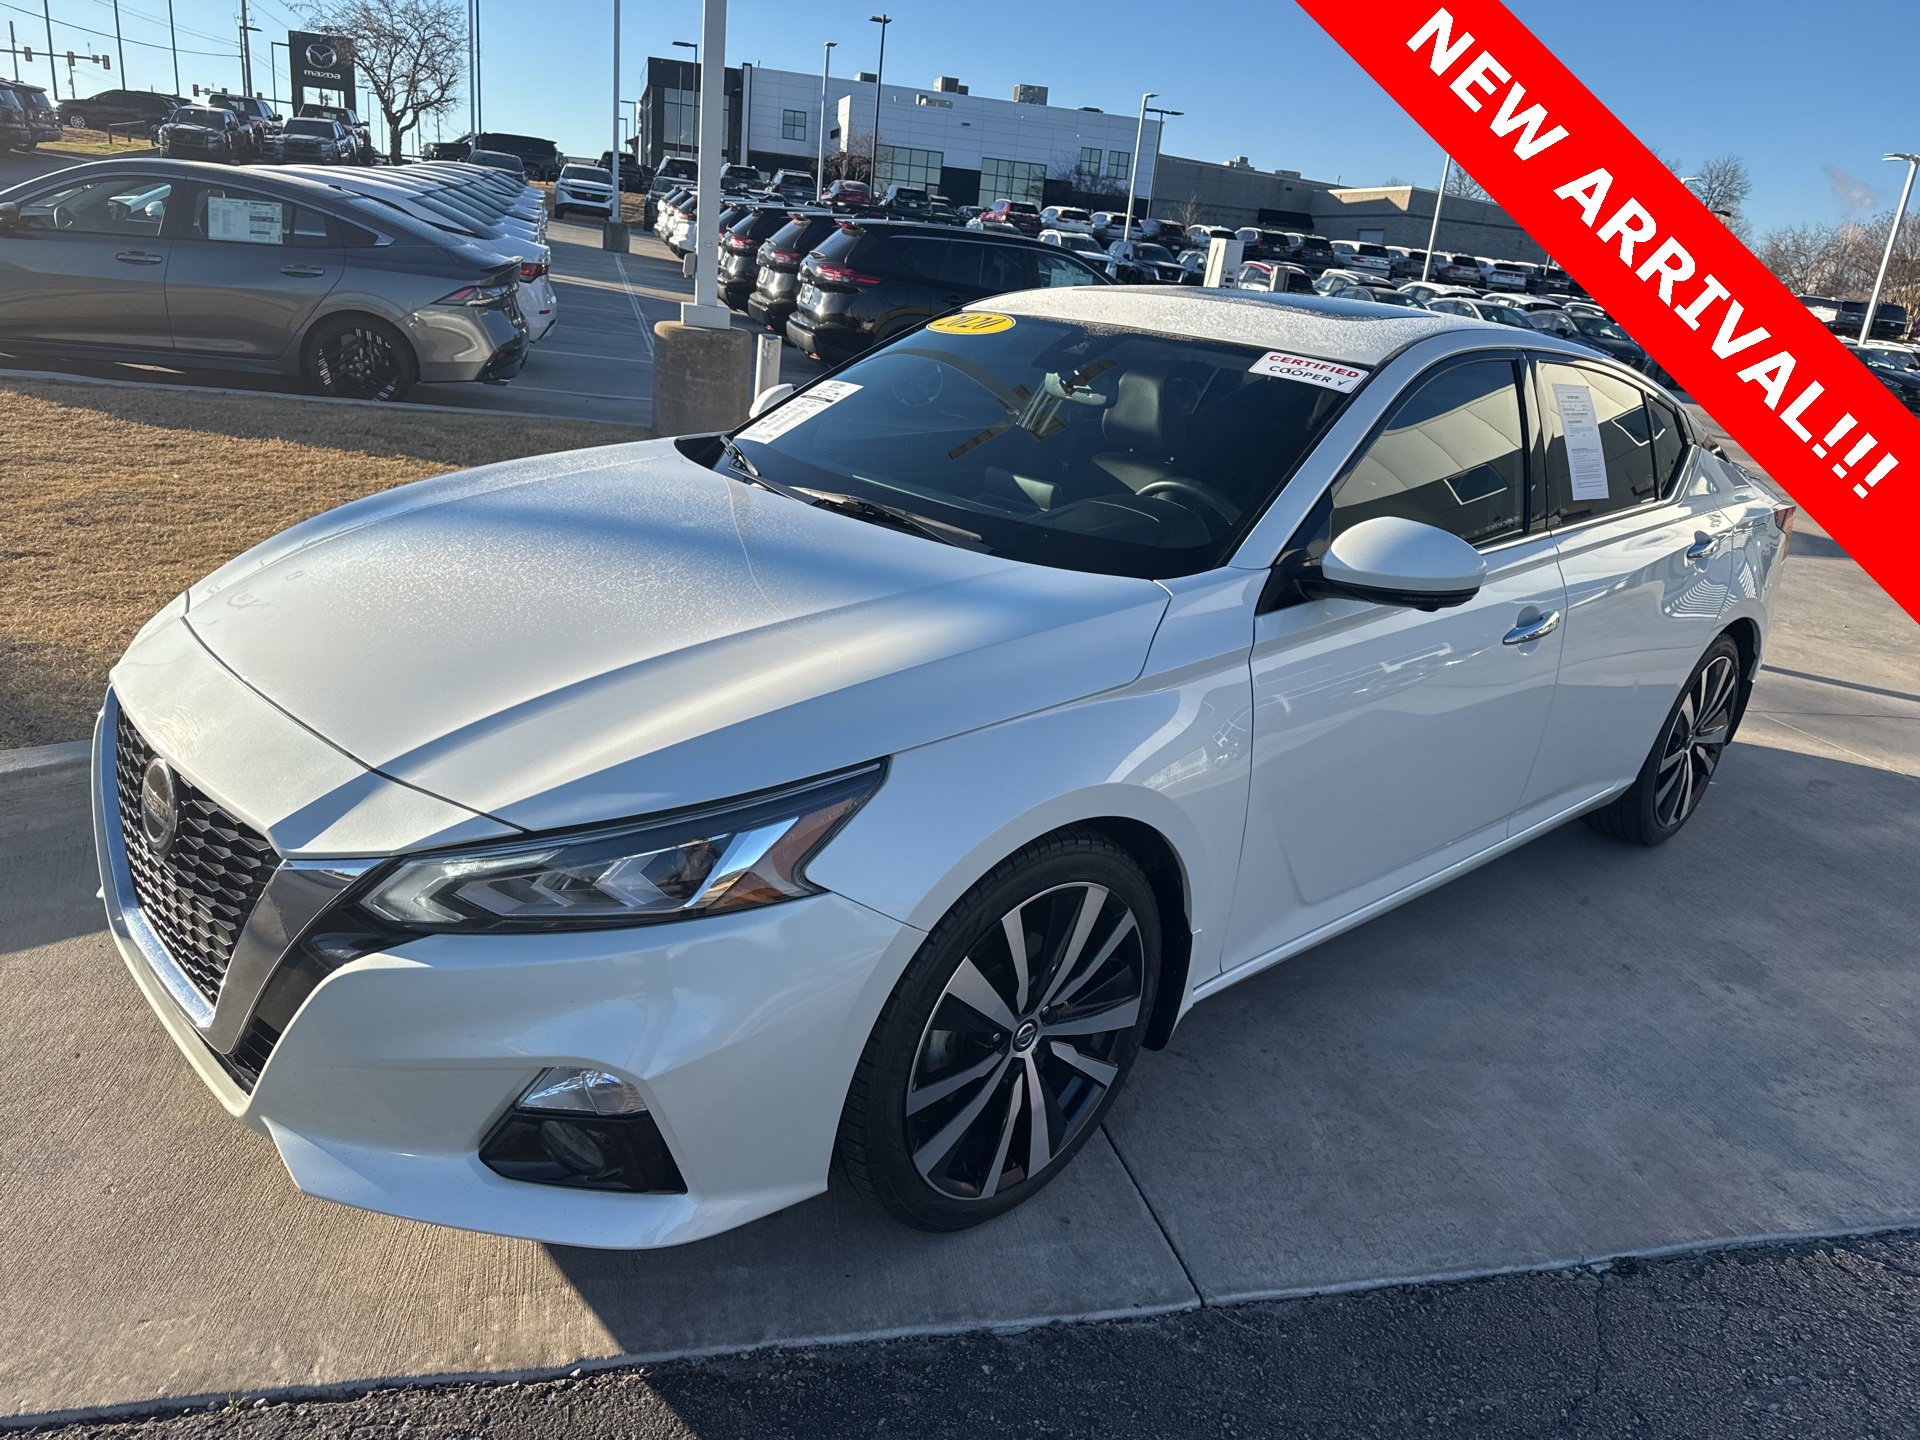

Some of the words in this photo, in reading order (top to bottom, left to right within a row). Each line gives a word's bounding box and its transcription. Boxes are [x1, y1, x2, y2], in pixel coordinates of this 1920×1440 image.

[304, 69, 341, 80] mazda
[934, 316, 1007, 330] 2020
[1269, 355, 1360, 378] CERTIFIED
[1269, 365, 1332, 383] COOPER
